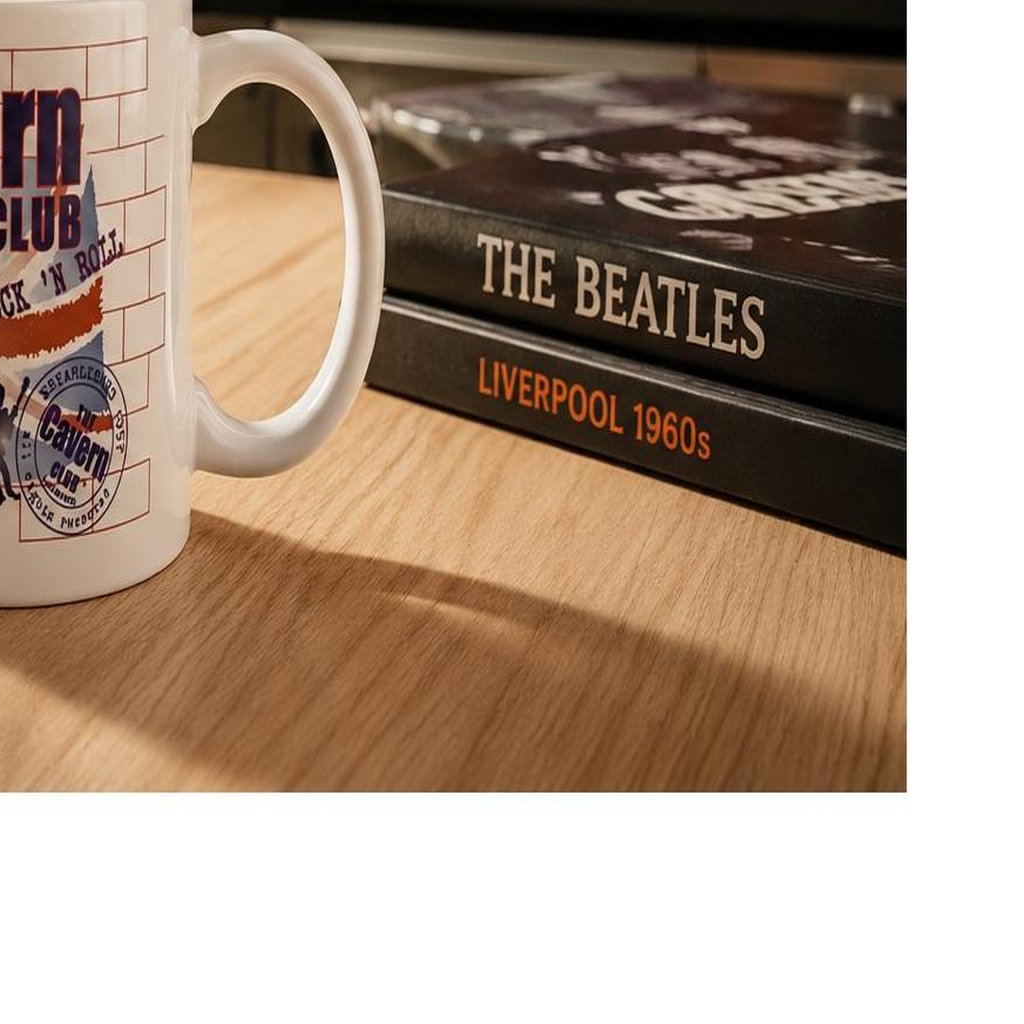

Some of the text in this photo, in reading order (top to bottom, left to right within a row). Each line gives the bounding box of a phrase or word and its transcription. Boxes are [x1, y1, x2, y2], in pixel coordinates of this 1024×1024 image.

[74, 228, 125, 282] ROLL
[477, 232, 766, 361] THE BEATLES
[39, 404, 110, 483] Cavern
[478, 357, 712, 461] LIVERPOOL 1960s
